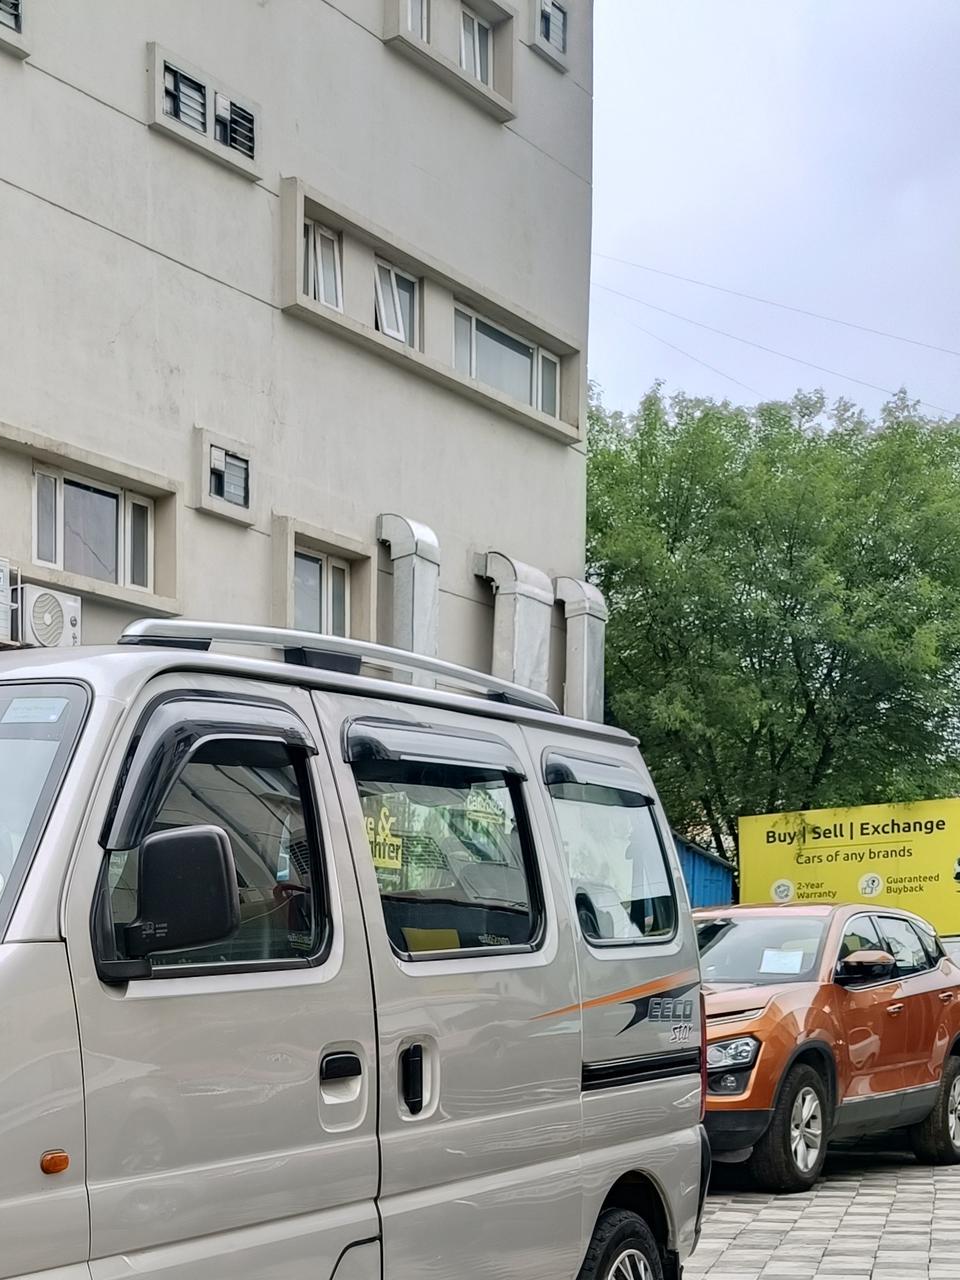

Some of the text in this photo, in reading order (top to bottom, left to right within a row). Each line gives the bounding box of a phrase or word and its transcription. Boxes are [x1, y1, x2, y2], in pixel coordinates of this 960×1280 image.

[766, 830, 797, 845] Buy
[812, 823, 845, 840] Sell
[860, 818, 946, 836] Exchange
[796, 846, 913, 865] Cars of any brands
[886, 873, 940, 885] Guaranteed
[796, 881, 824, 891] 2-Year
[886, 885, 924, 895] Buyback
[796, 891, 837, 900] Warranty
[648, 997, 693, 1022] EECO
